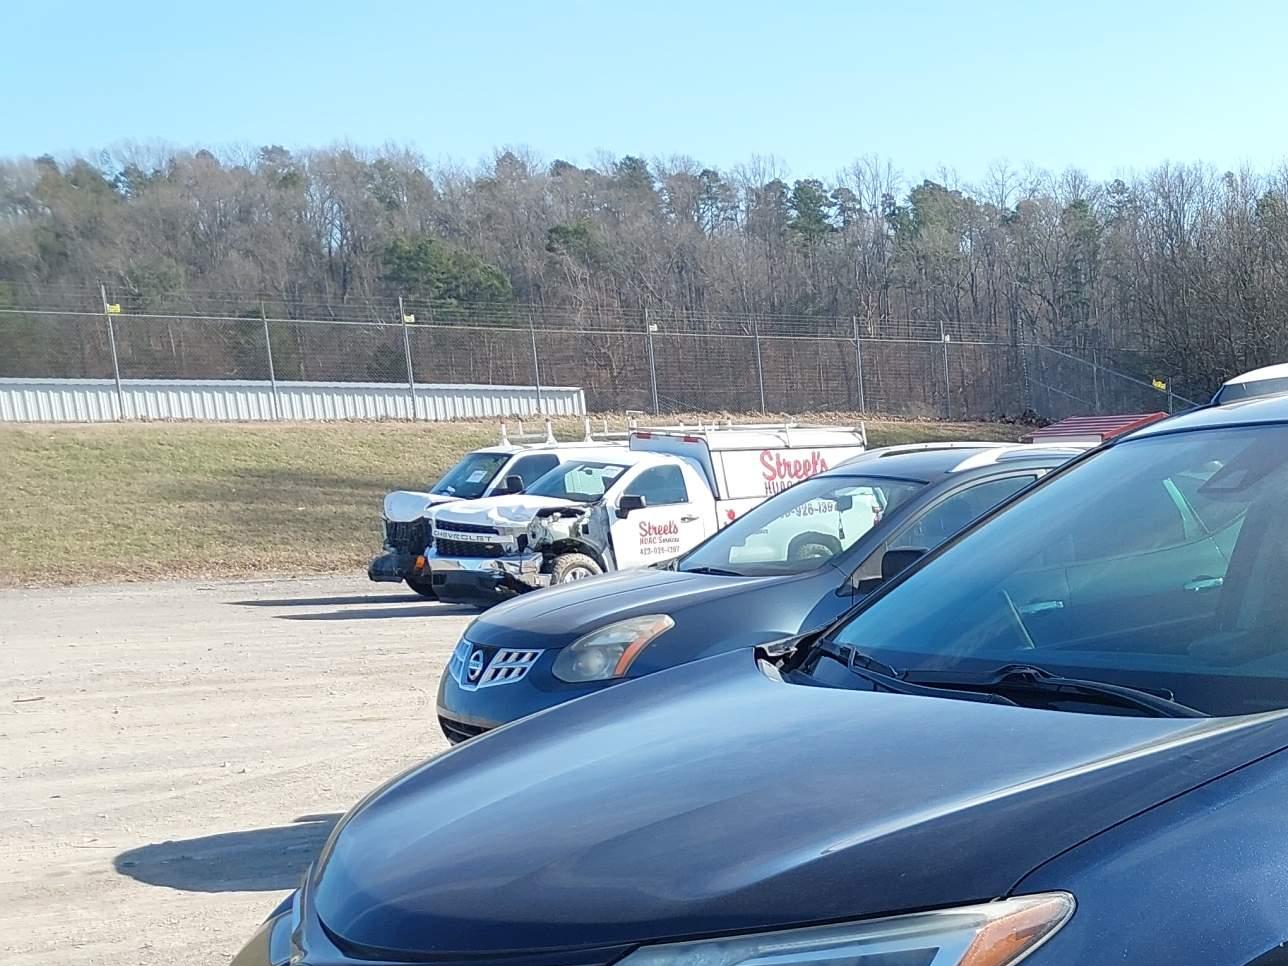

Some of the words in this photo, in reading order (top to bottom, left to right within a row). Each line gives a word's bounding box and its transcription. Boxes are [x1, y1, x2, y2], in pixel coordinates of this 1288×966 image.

[760, 448, 829, 481] Street's
[433, 530, 492, 542] CHEVROLET
[639, 520, 679, 537] Street's
